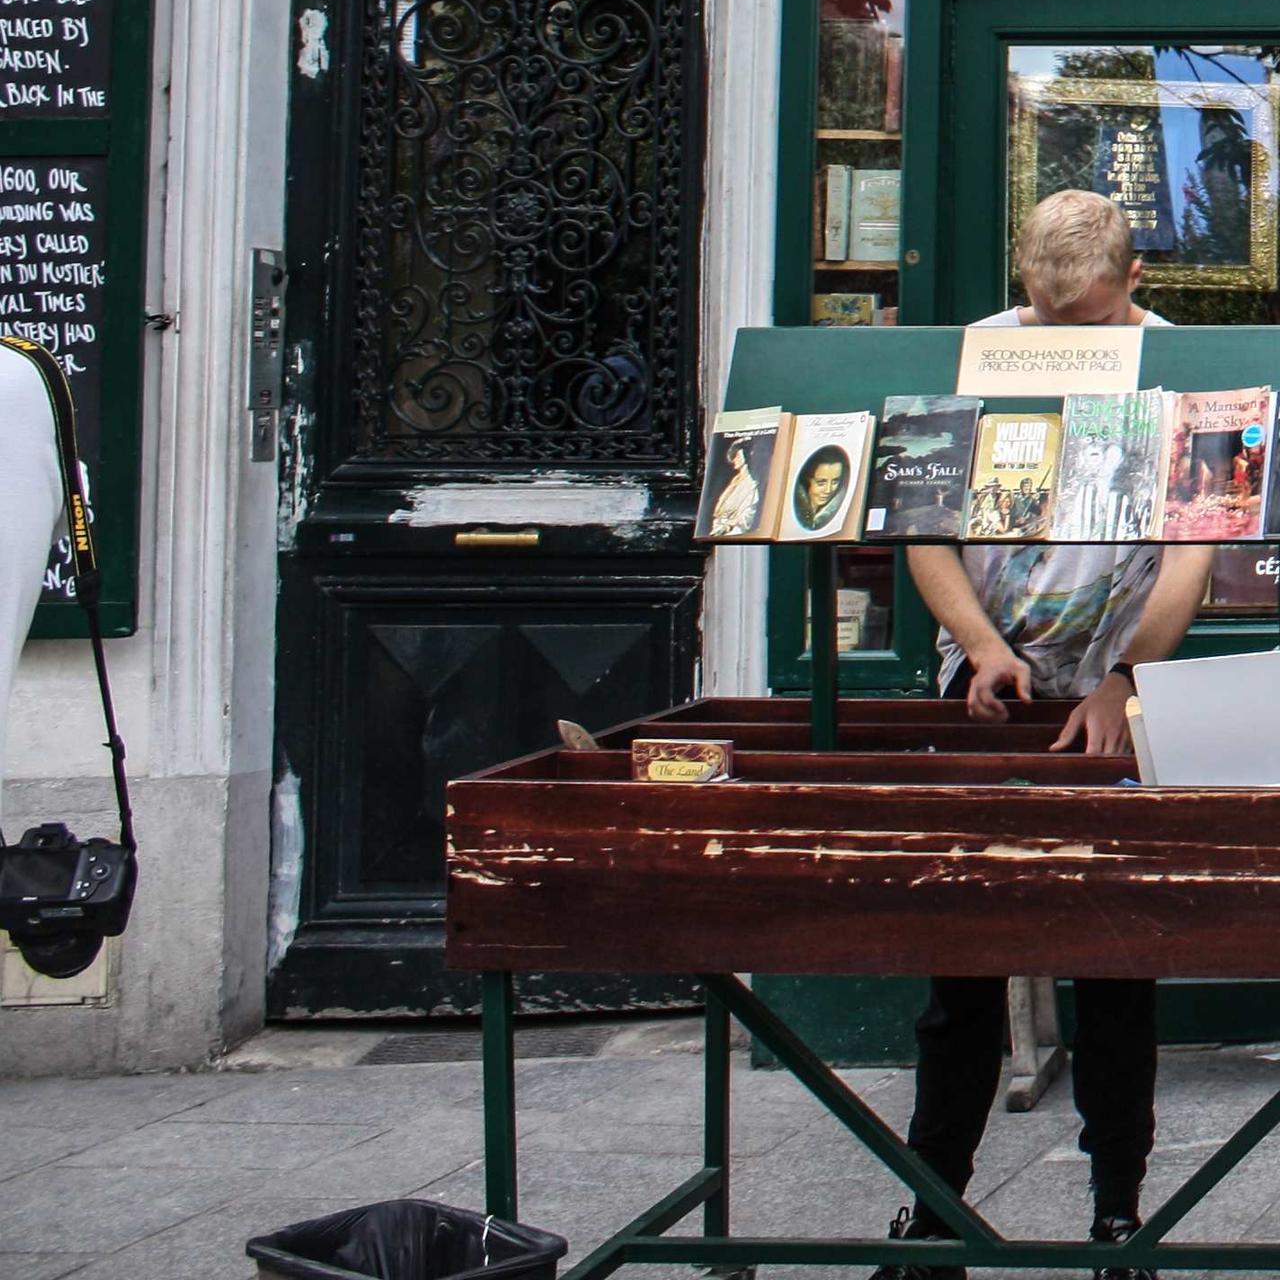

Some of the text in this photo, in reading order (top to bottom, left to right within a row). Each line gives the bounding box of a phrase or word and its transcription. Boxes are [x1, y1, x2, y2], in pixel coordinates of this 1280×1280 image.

[61, 16, 89, 48] BY
[6, 82, 106, 108] BACK IN THE
[48, 167, 88, 194] OUR
[59, 201, 95, 223] WAS
[36, 233, 89, 255] CALLED
[16, 263, 37, 285] DU
[33, 291, 86, 313] TIMES
[64, 322, 97, 346] HAD
[981, 349, 1119, 361] SECOND-HAND BOOKS
[1022, 361, 1042, 372] ON
[1045, 361, 1088, 372] FRONT
[1203, 399, 1257, 413] Mansion
[996, 422, 1048, 441] WILBUR
[991, 441, 1045, 464] SMITH
[925, 463, 960, 480] FALL
[71, 493, 90, 552] Nikon
